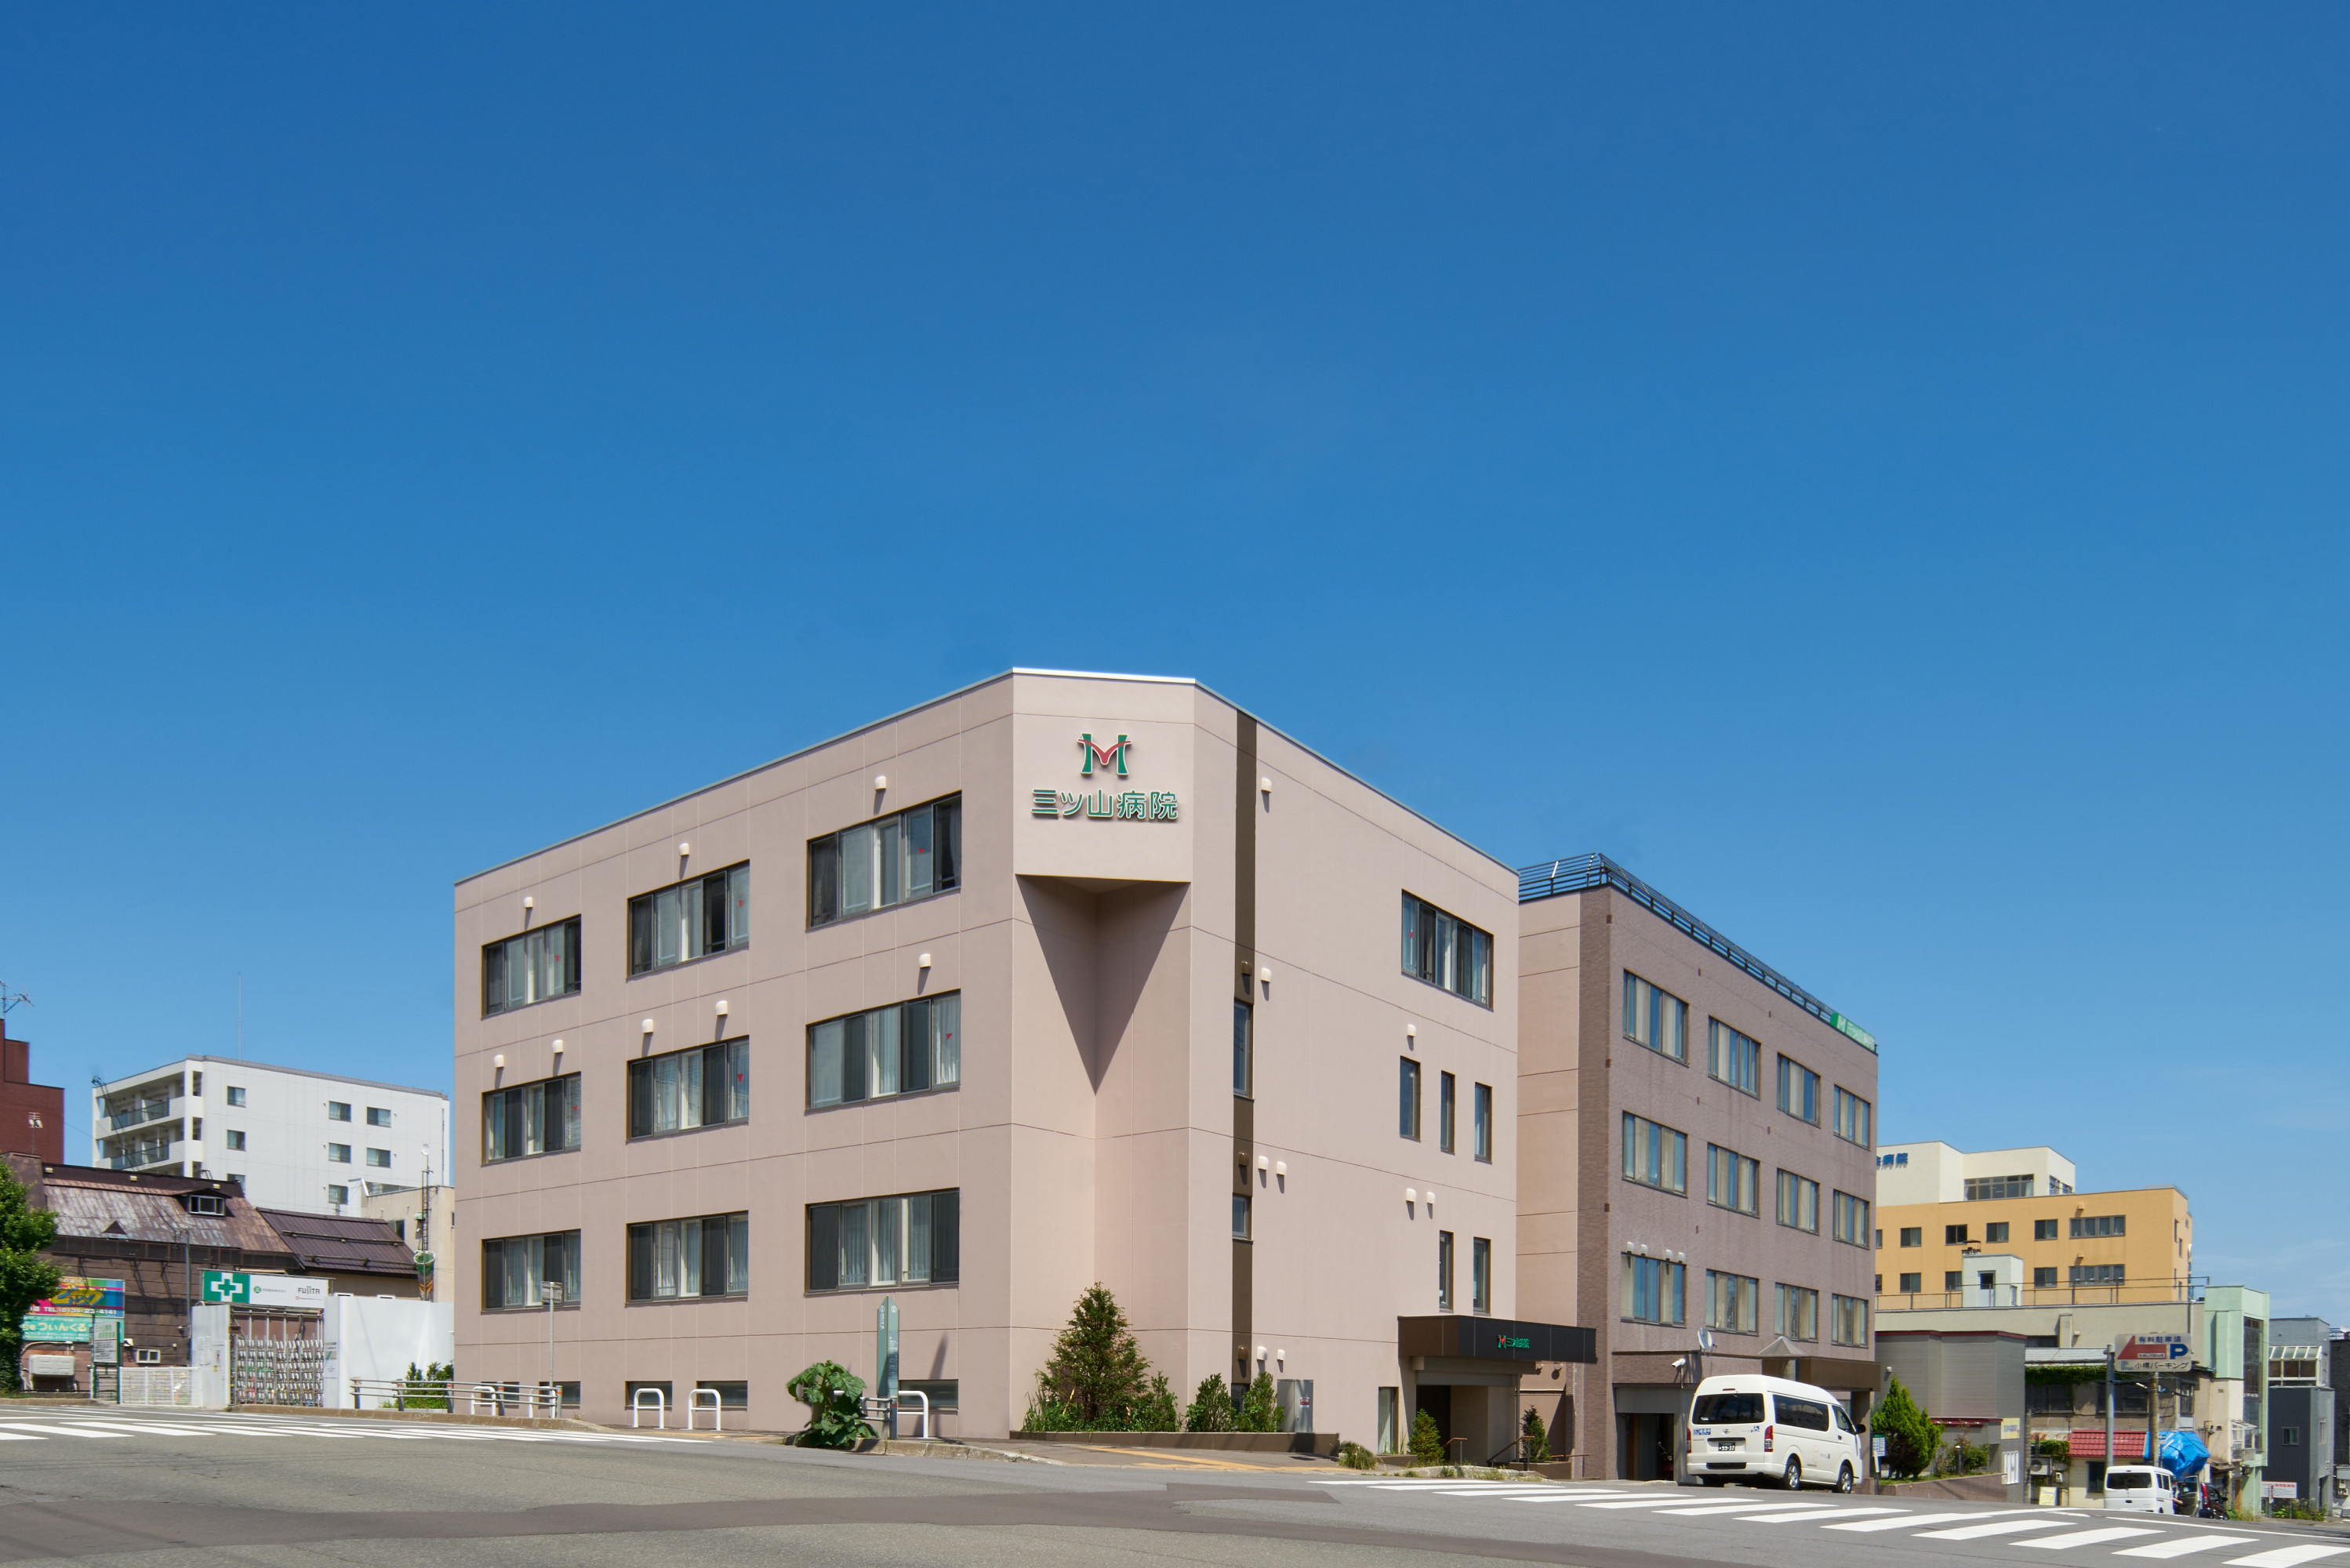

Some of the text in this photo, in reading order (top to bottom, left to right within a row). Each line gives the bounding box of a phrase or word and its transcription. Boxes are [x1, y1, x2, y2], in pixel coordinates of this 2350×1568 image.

[1030, 789, 1179, 819] 三ツ山病院
[38, 1322, 88, 1332] ついんくる
[2170, 1344, 2188, 1359] P
